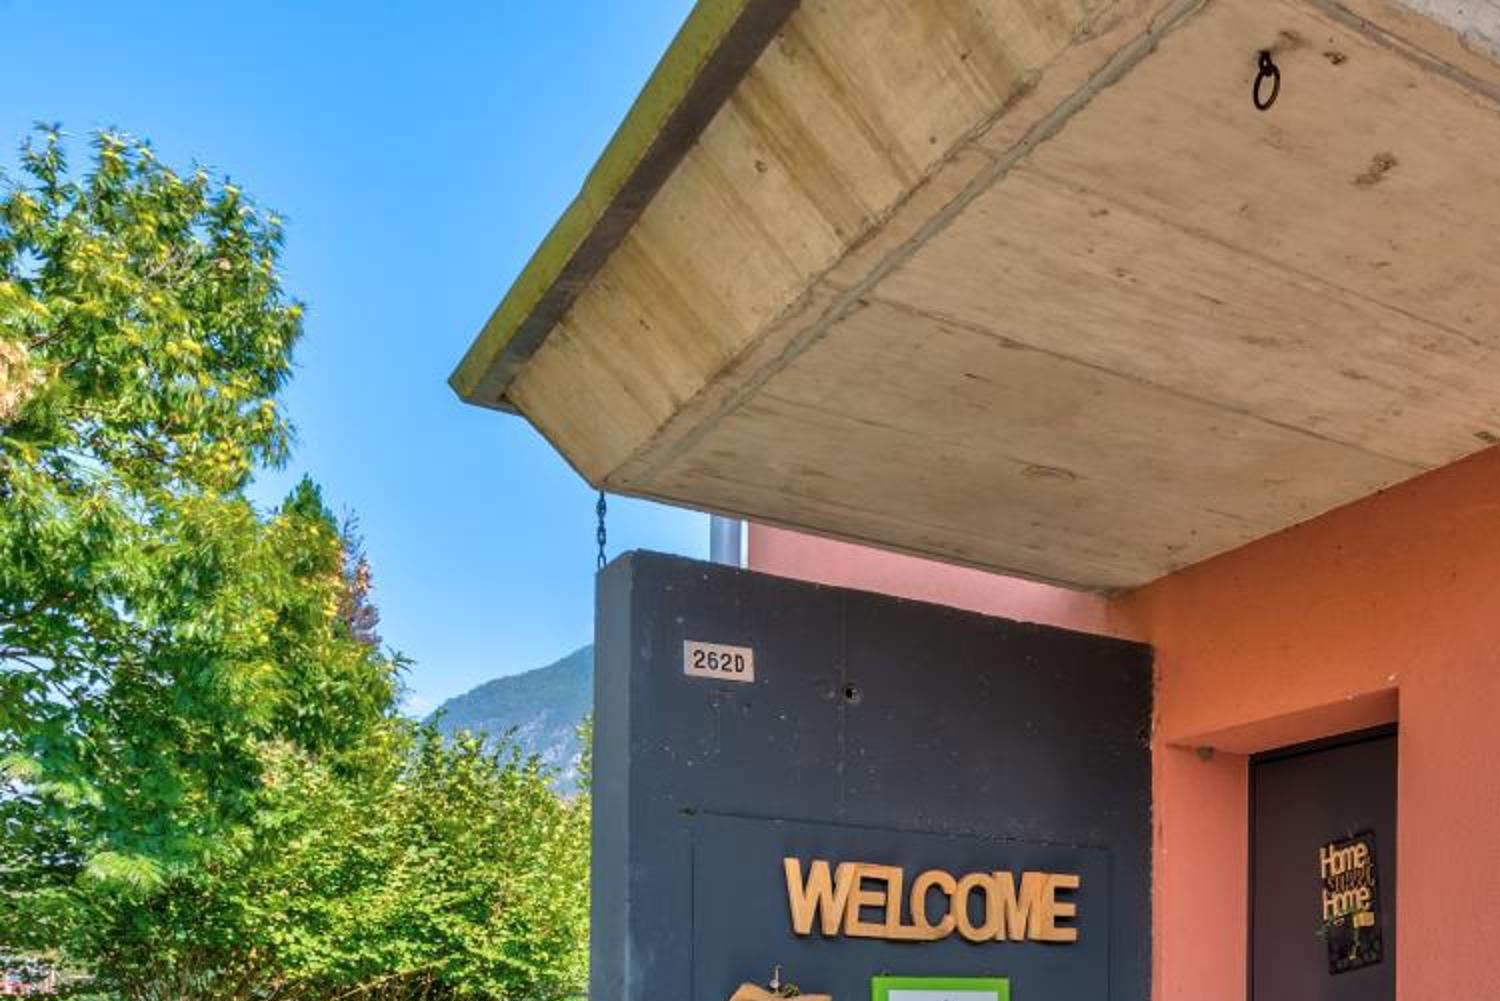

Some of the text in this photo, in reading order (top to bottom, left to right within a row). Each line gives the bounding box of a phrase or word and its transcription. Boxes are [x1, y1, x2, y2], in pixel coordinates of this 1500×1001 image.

[1319, 841, 1369, 879] Home
[783, 856, 1080, 943] WELCOME
[1321, 886, 1371, 921] Home
